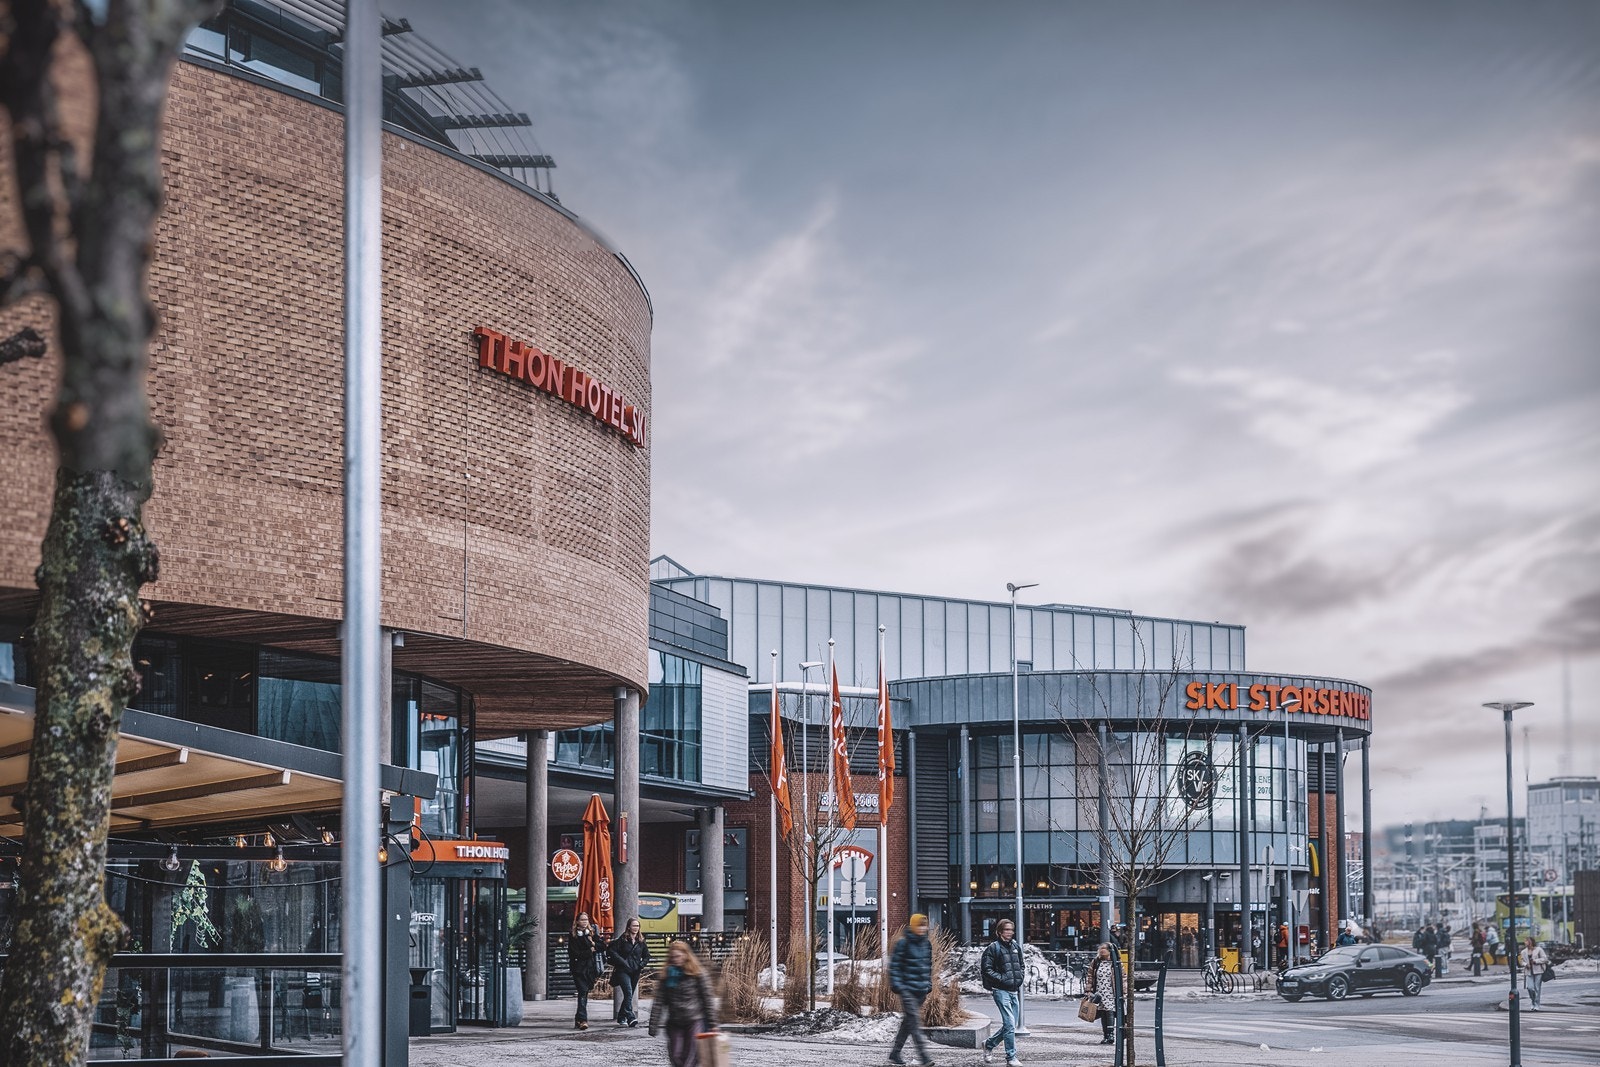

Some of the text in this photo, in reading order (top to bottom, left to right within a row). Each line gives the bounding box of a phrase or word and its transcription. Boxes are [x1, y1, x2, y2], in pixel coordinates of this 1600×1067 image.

[474, 327, 647, 448] THON HOTEL SKI
[1186, 682, 1371, 720] SKI STORSENTER
[456, 845, 491, 858] THON
[832, 850, 870, 865] MENY
[413, 912, 438, 922] THON
